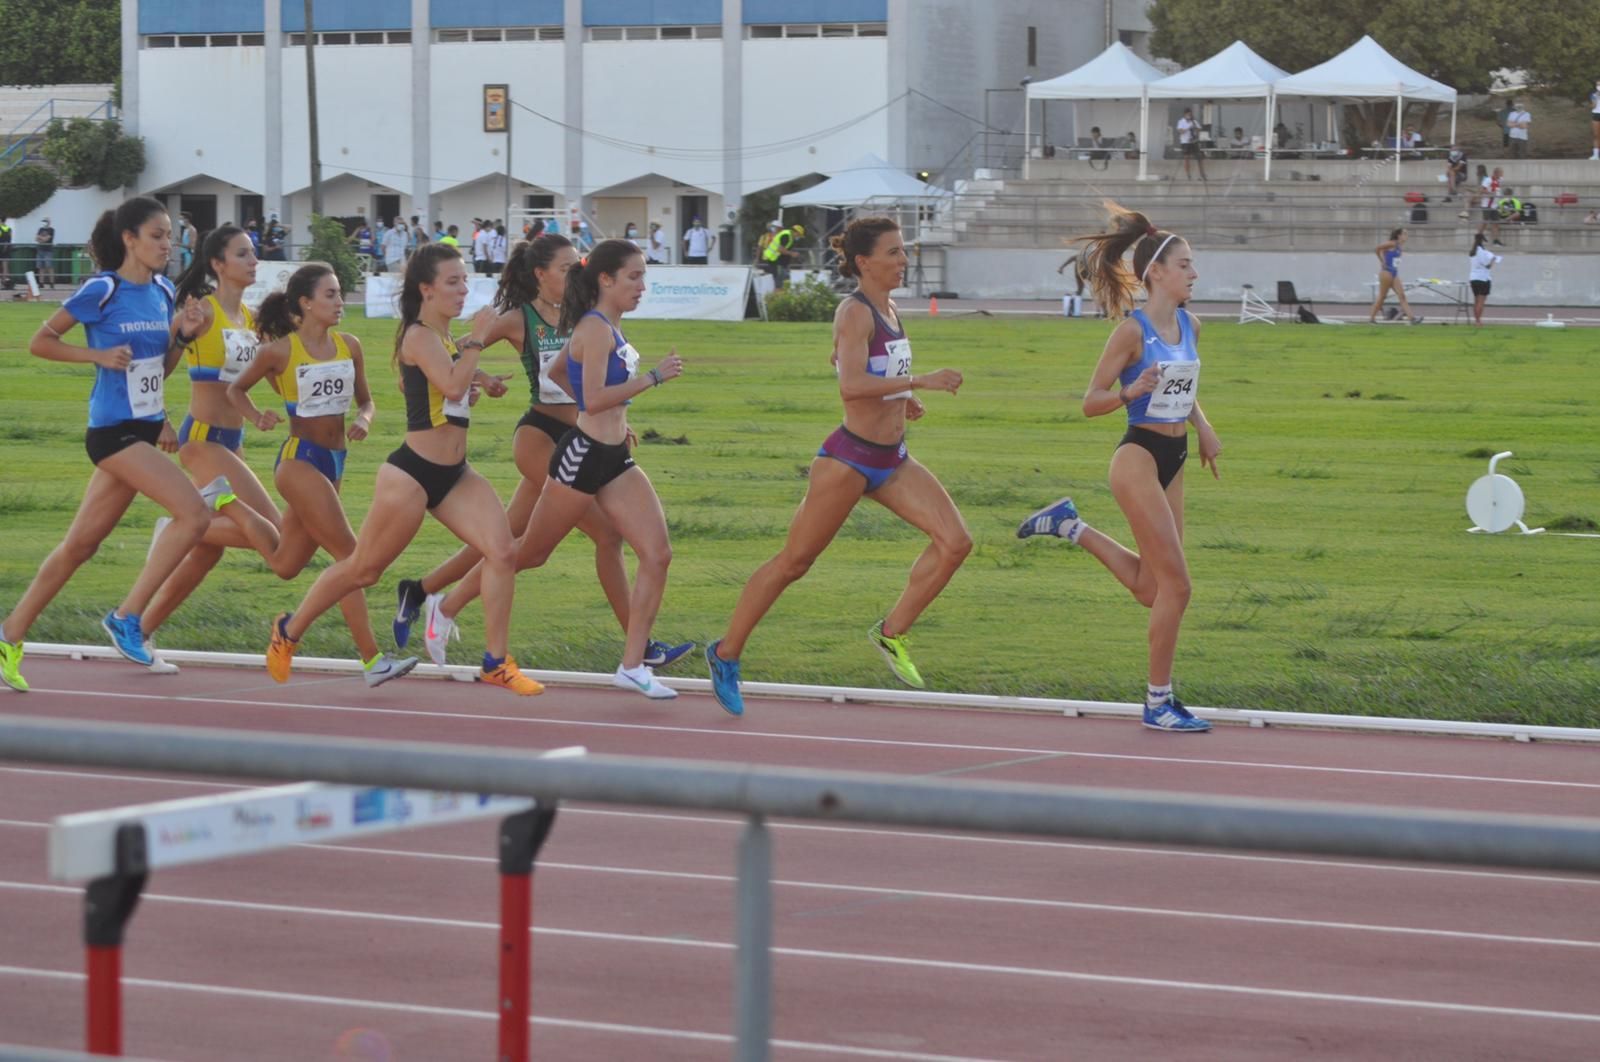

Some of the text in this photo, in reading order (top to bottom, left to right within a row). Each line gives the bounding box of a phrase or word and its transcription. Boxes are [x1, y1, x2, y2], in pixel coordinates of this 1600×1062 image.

[651, 282, 728, 296] Torremolinos
[311, 378, 344, 397] 269
[1163, 378, 1193, 395] 254
